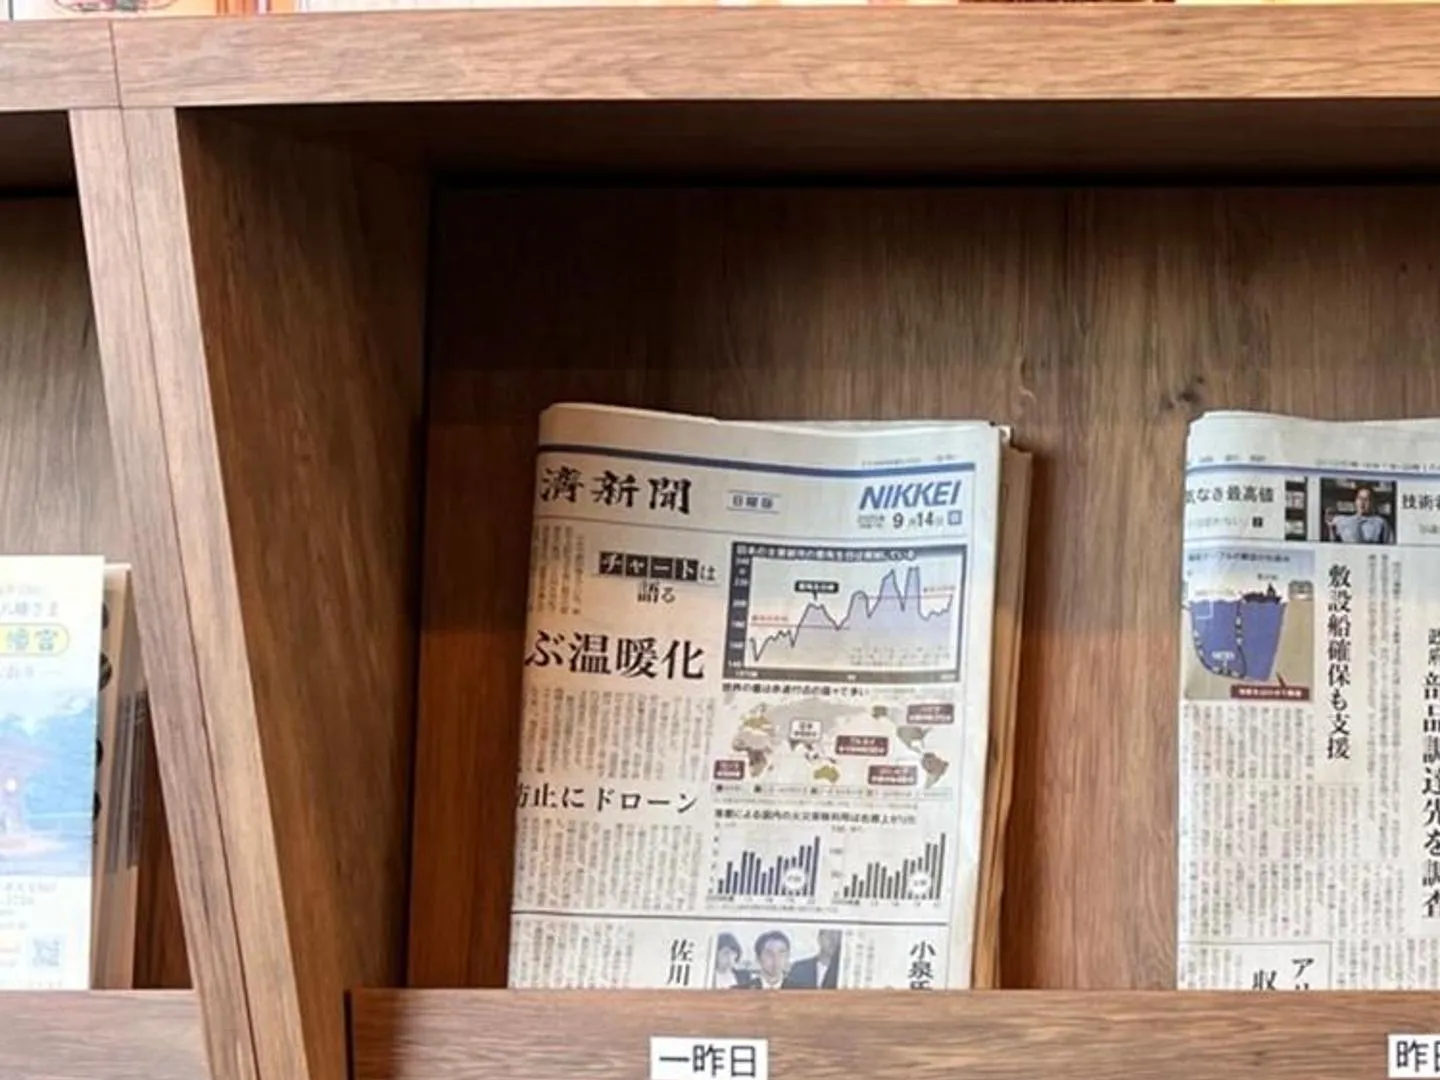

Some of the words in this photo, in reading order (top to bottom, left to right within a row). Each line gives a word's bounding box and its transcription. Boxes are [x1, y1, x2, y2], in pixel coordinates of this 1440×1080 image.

[859, 480, 962, 510] NIKKEI
[637, 582, 676, 604] 語る
[524, 629, 705, 680] ぶ温暖化
[1327, 562, 1352, 760] 敷設船確保も支援
[667, 938, 694, 986] 佐川
[659, 1045, 756, 1078] 一昨日
